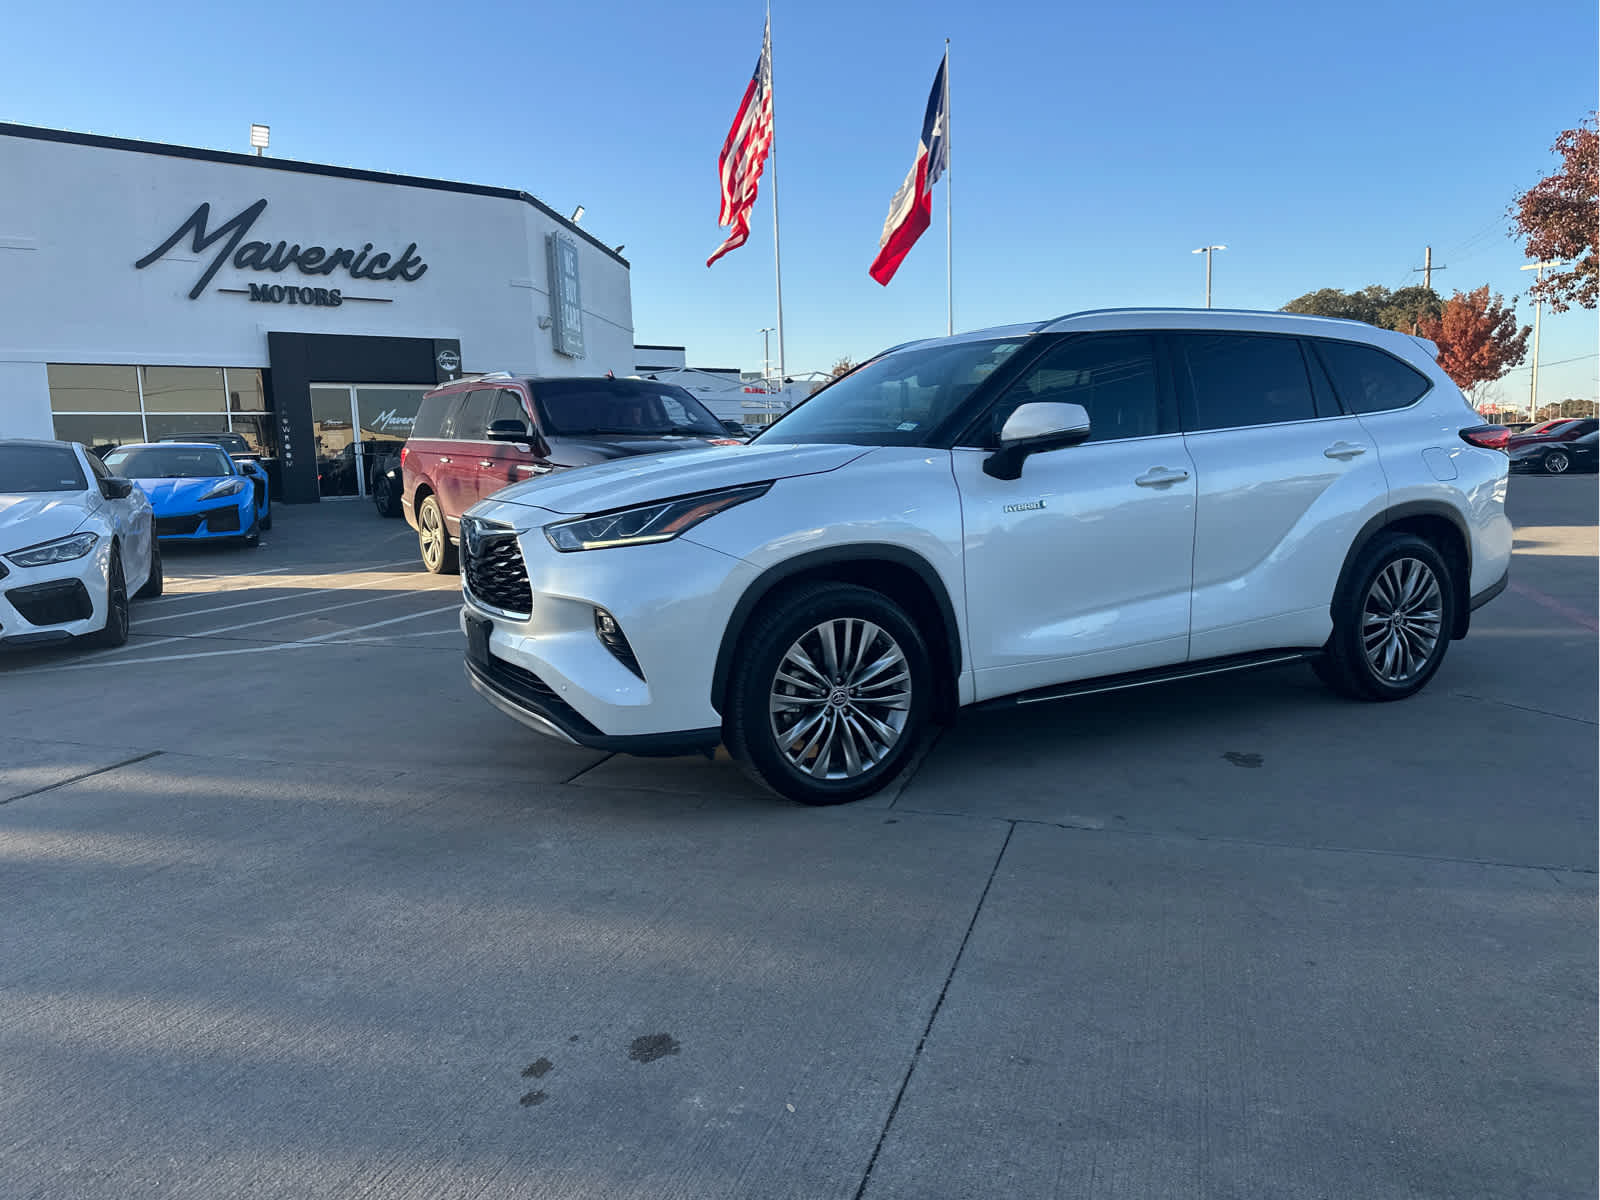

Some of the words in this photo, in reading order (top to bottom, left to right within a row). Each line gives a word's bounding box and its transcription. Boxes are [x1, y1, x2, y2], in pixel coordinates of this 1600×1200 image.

[135, 198, 428, 301] Maverick
[247, 283, 343, 307] MOTORS
[1003, 501, 1041, 513] HYBRID
